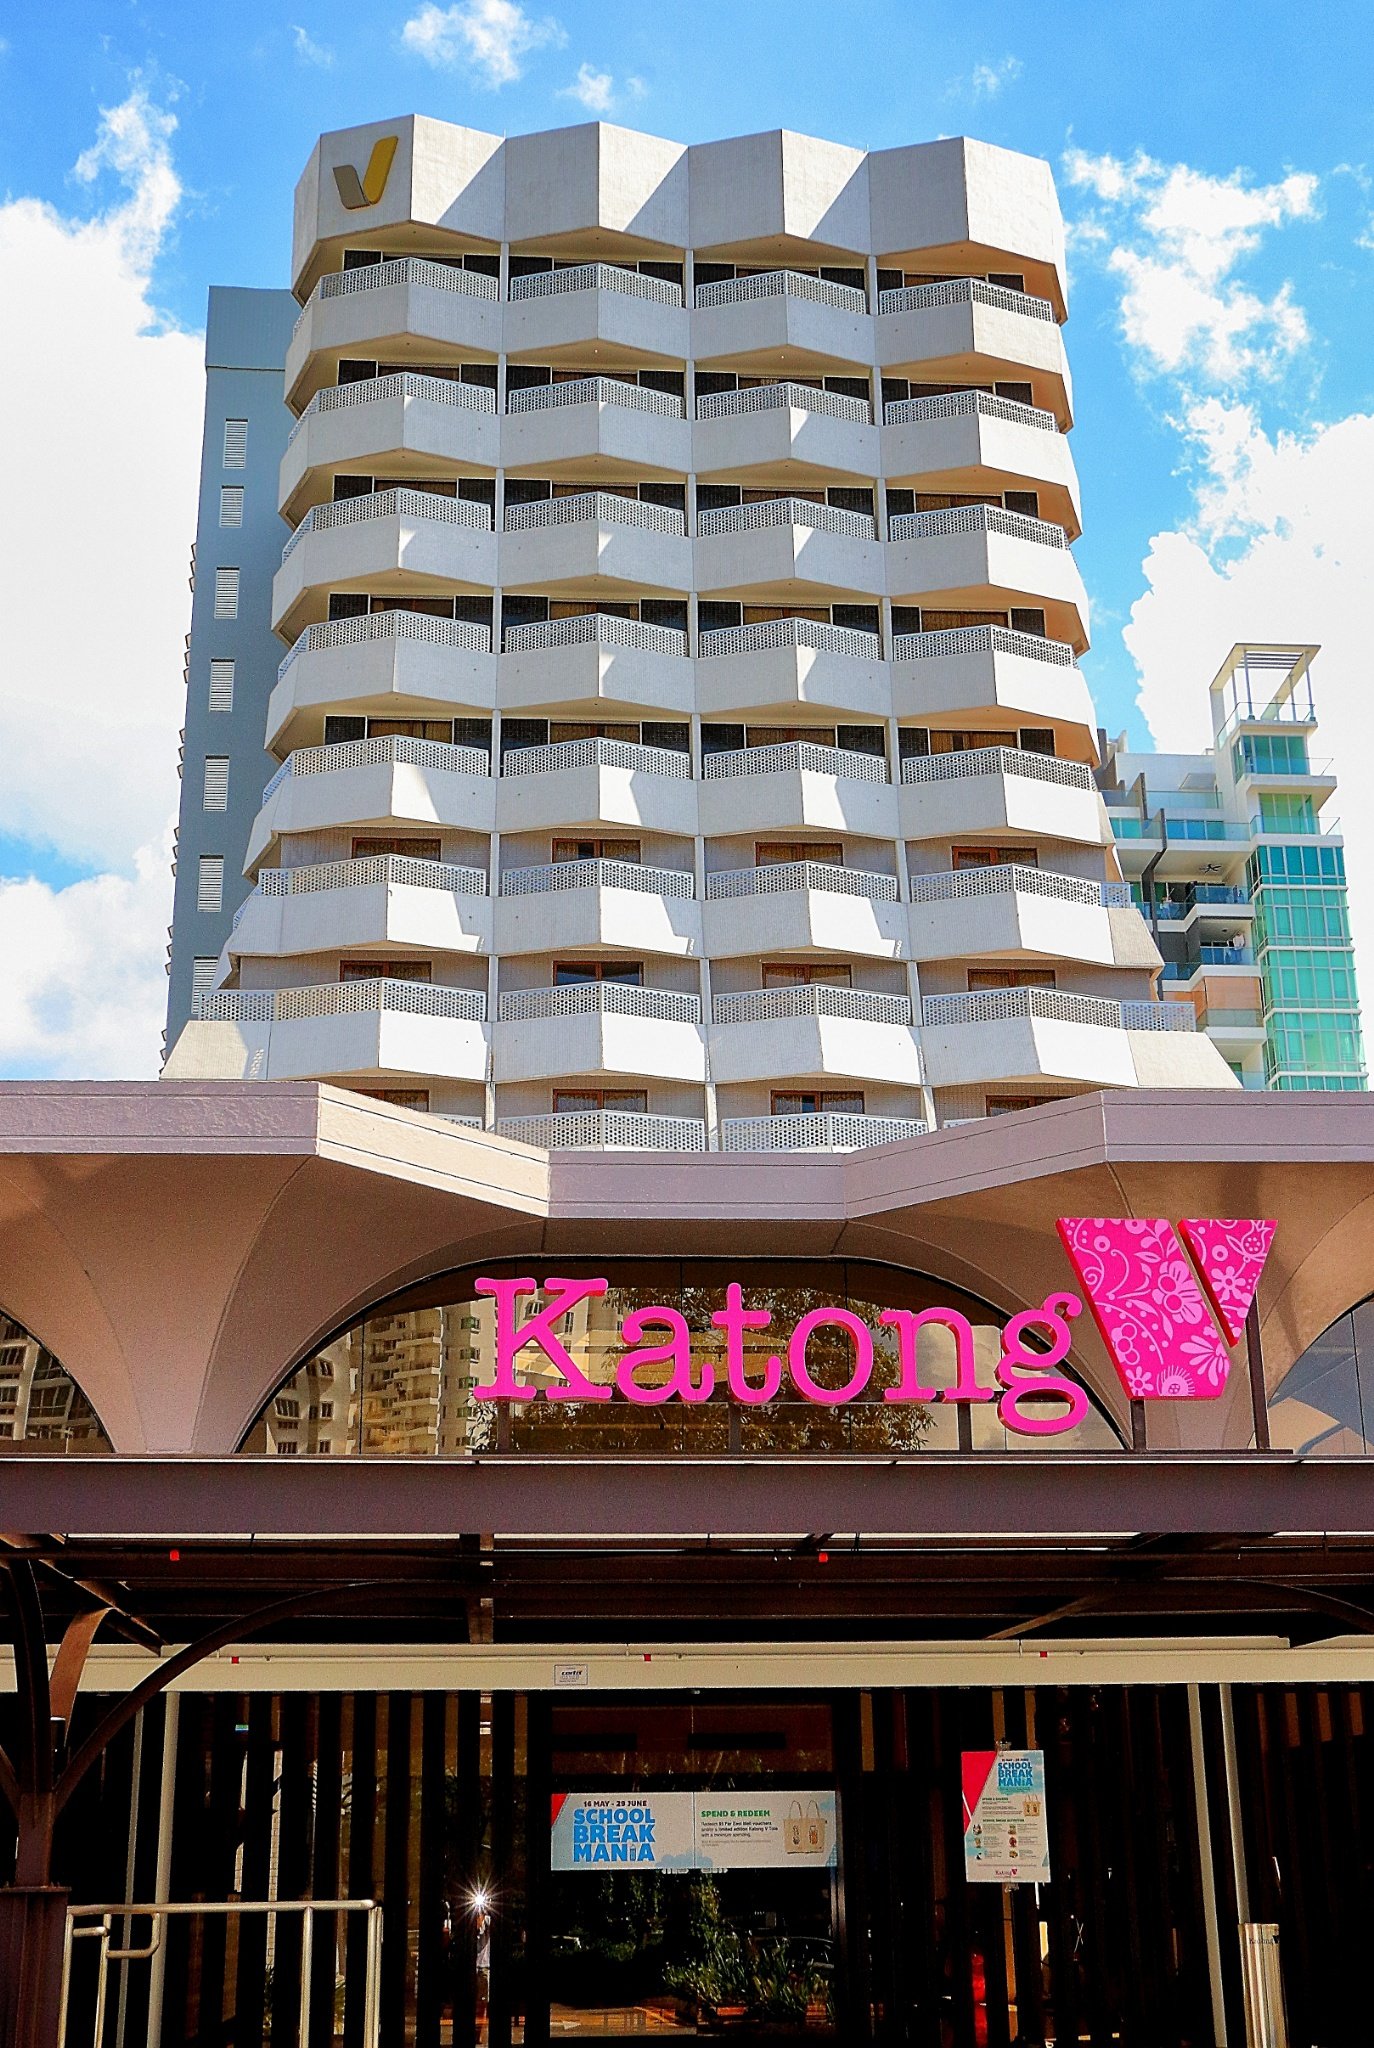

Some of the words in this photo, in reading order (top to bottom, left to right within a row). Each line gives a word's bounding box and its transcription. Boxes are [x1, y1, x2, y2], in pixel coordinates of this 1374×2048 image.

[473, 1276, 1089, 1437] Katong
[1055, 1218, 1279, 1400] V
[998, 1769, 1033, 1777] BREAK
[573, 1808, 655, 1824] SCHOOL
[737, 1809, 771, 1817] REDEEM
[573, 1824, 656, 1843] BREAK
